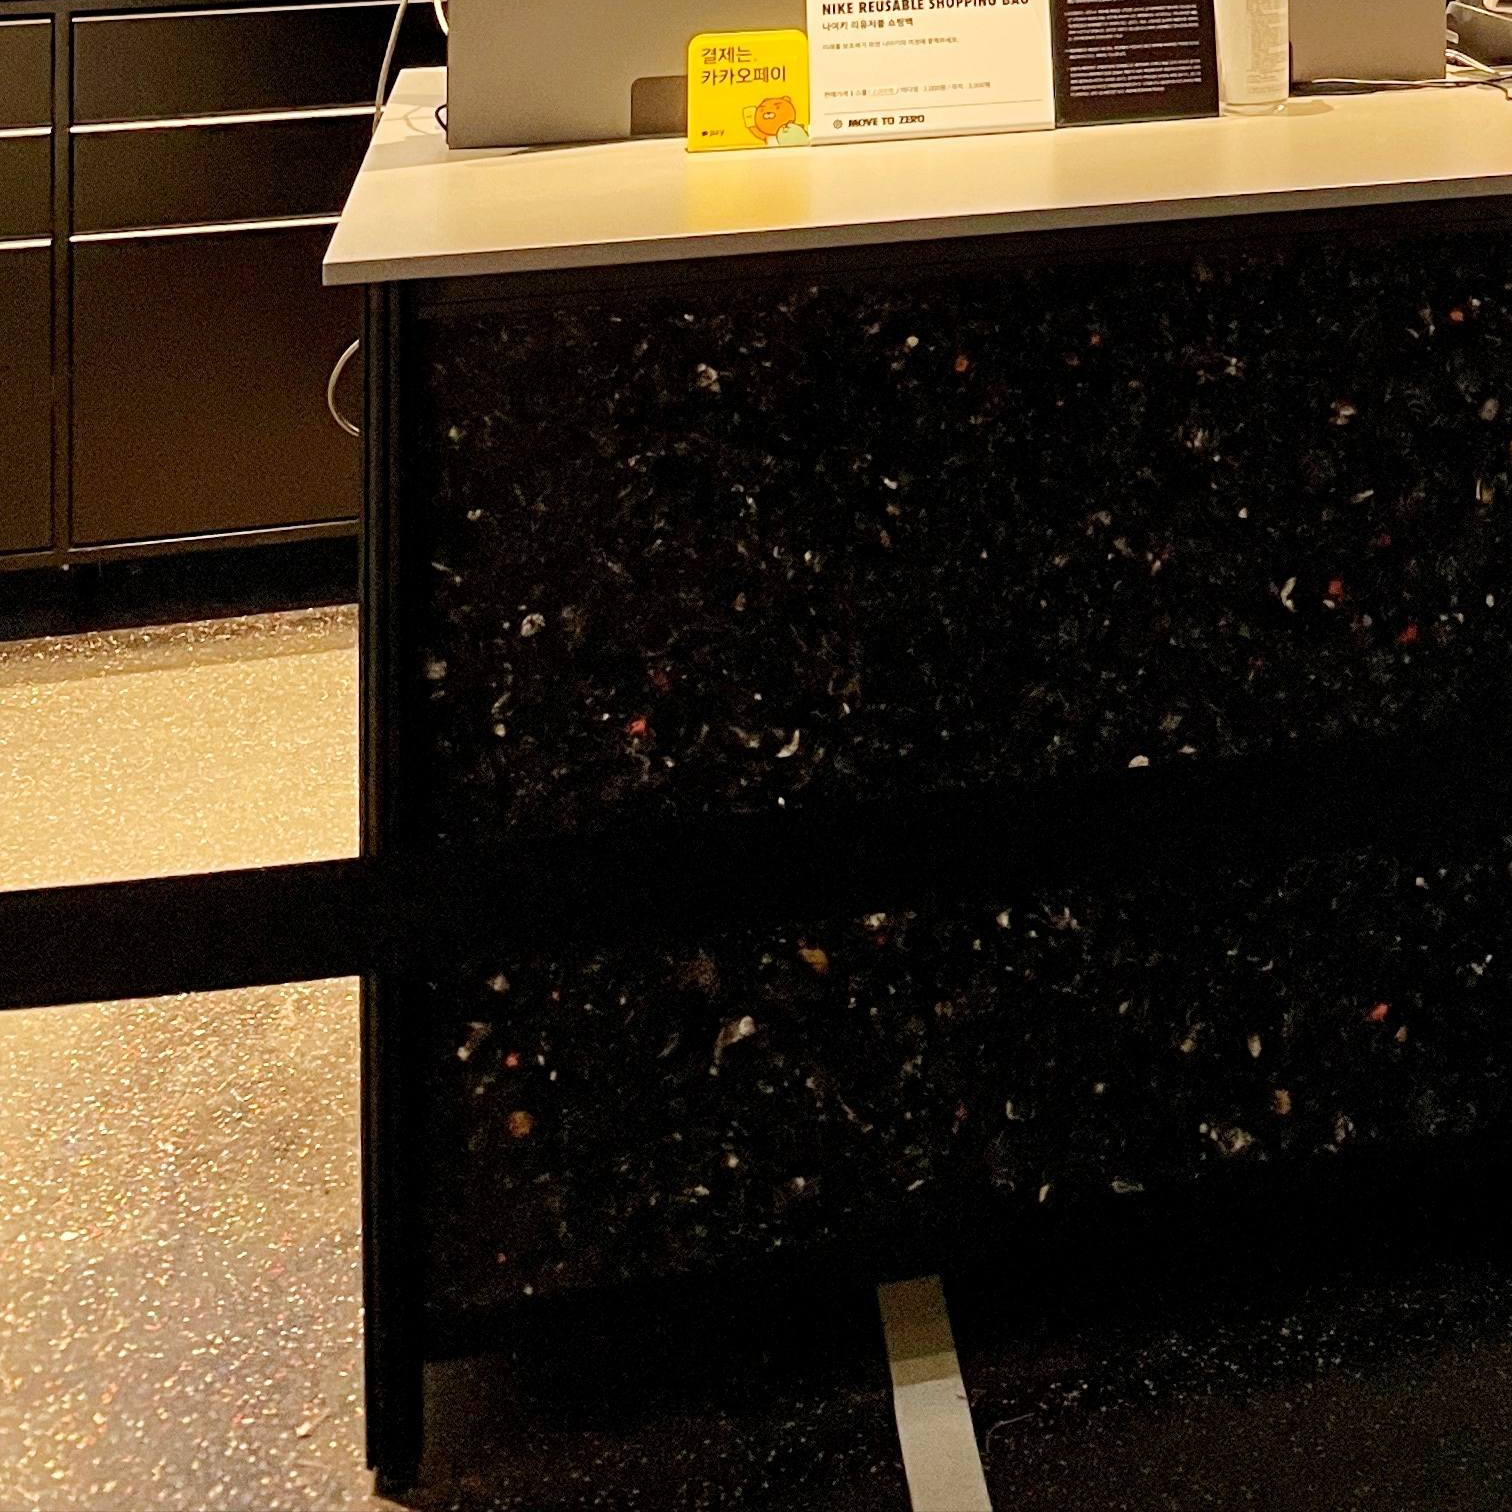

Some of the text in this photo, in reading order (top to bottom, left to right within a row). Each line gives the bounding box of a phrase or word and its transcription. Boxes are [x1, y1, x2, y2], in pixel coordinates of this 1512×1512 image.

[822, 2, 853, 16] NIKE
[701, 65, 785, 86] 카카오페이
[848, 114, 925, 128] MOVE TO ZERO
